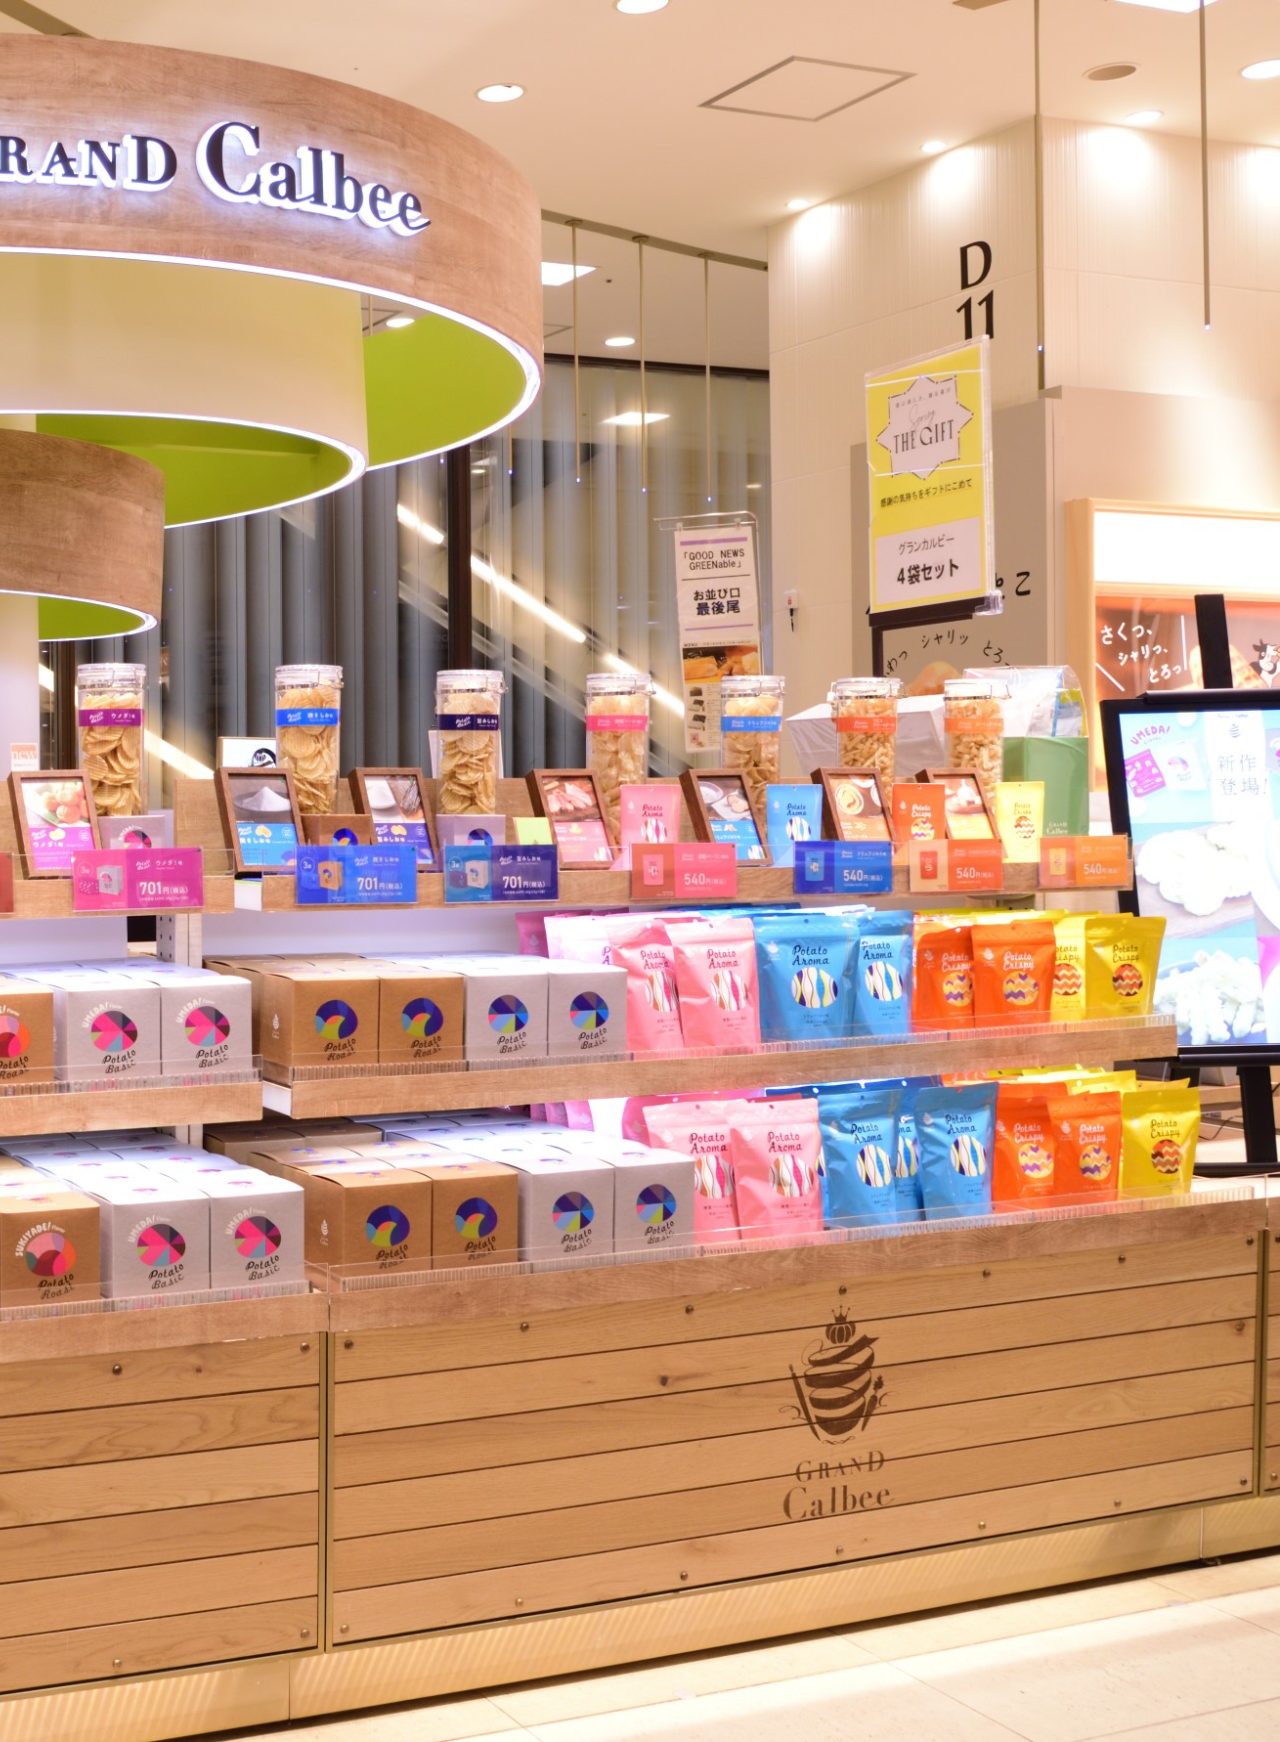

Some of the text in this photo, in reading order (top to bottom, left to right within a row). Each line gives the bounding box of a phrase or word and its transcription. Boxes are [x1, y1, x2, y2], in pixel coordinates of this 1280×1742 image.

[197, 121, 431, 235] Calbee
[960, 241, 992, 290] D
[956, 290, 994, 340] 11
[894, 419, 954, 454] THE GIFT
[898, 534, 955, 556] グランカルビー
[721, 549, 744, 558] NEWS
[897, 559, 959, 585] 4袋セット
[694, 588, 740, 601] お並び口
[697, 600, 740, 615] 最後尾
[1218, 754, 1256, 772] 新作
[792, 945, 828, 957] Potato
[862, 941, 890, 951] Potato
[792, 956, 829, 966] Aroma
[863, 950, 893, 960] Aroma
[1056, 953, 1079, 962] ispy
[497, 1031, 527, 1045] Potato
[578, 1027, 608, 1041] Potato
[324, 1038, 356, 1052] Potato
[410, 1035, 442, 1048] Potato
[102, 1049, 136, 1064] Potato
[194, 1044, 229, 1060] Potato
[945, 1114, 972, 1124] Potato
[1150, 1119, 1178, 1129] Potato
[851, 1123, 879, 1135] Potato
[947, 1124, 976, 1135] Aroma
[1150, 1128, 1180, 1138] Crispy
[689, 1132, 725, 1144] Potato
[768, 1132, 799, 1142] Potato
[853, 1133, 882, 1144] Aroma
[689, 1143, 727, 1153] Aroma
[768, 1141, 802, 1152] Aroma
[645, 1220, 675, 1236] Potato
[561, 1228, 593, 1243] Potato
[464, 1235, 496, 1252] Potato
[375, 1243, 408, 1261] Potato
[245, 1255, 280, 1271] Potato
[148, 1263, 184, 1280] Potato
[38, 1272, 75, 1289] Potato
[796, 1451, 885, 1482] GRAND
[783, 1475, 895, 1519] Calbee
